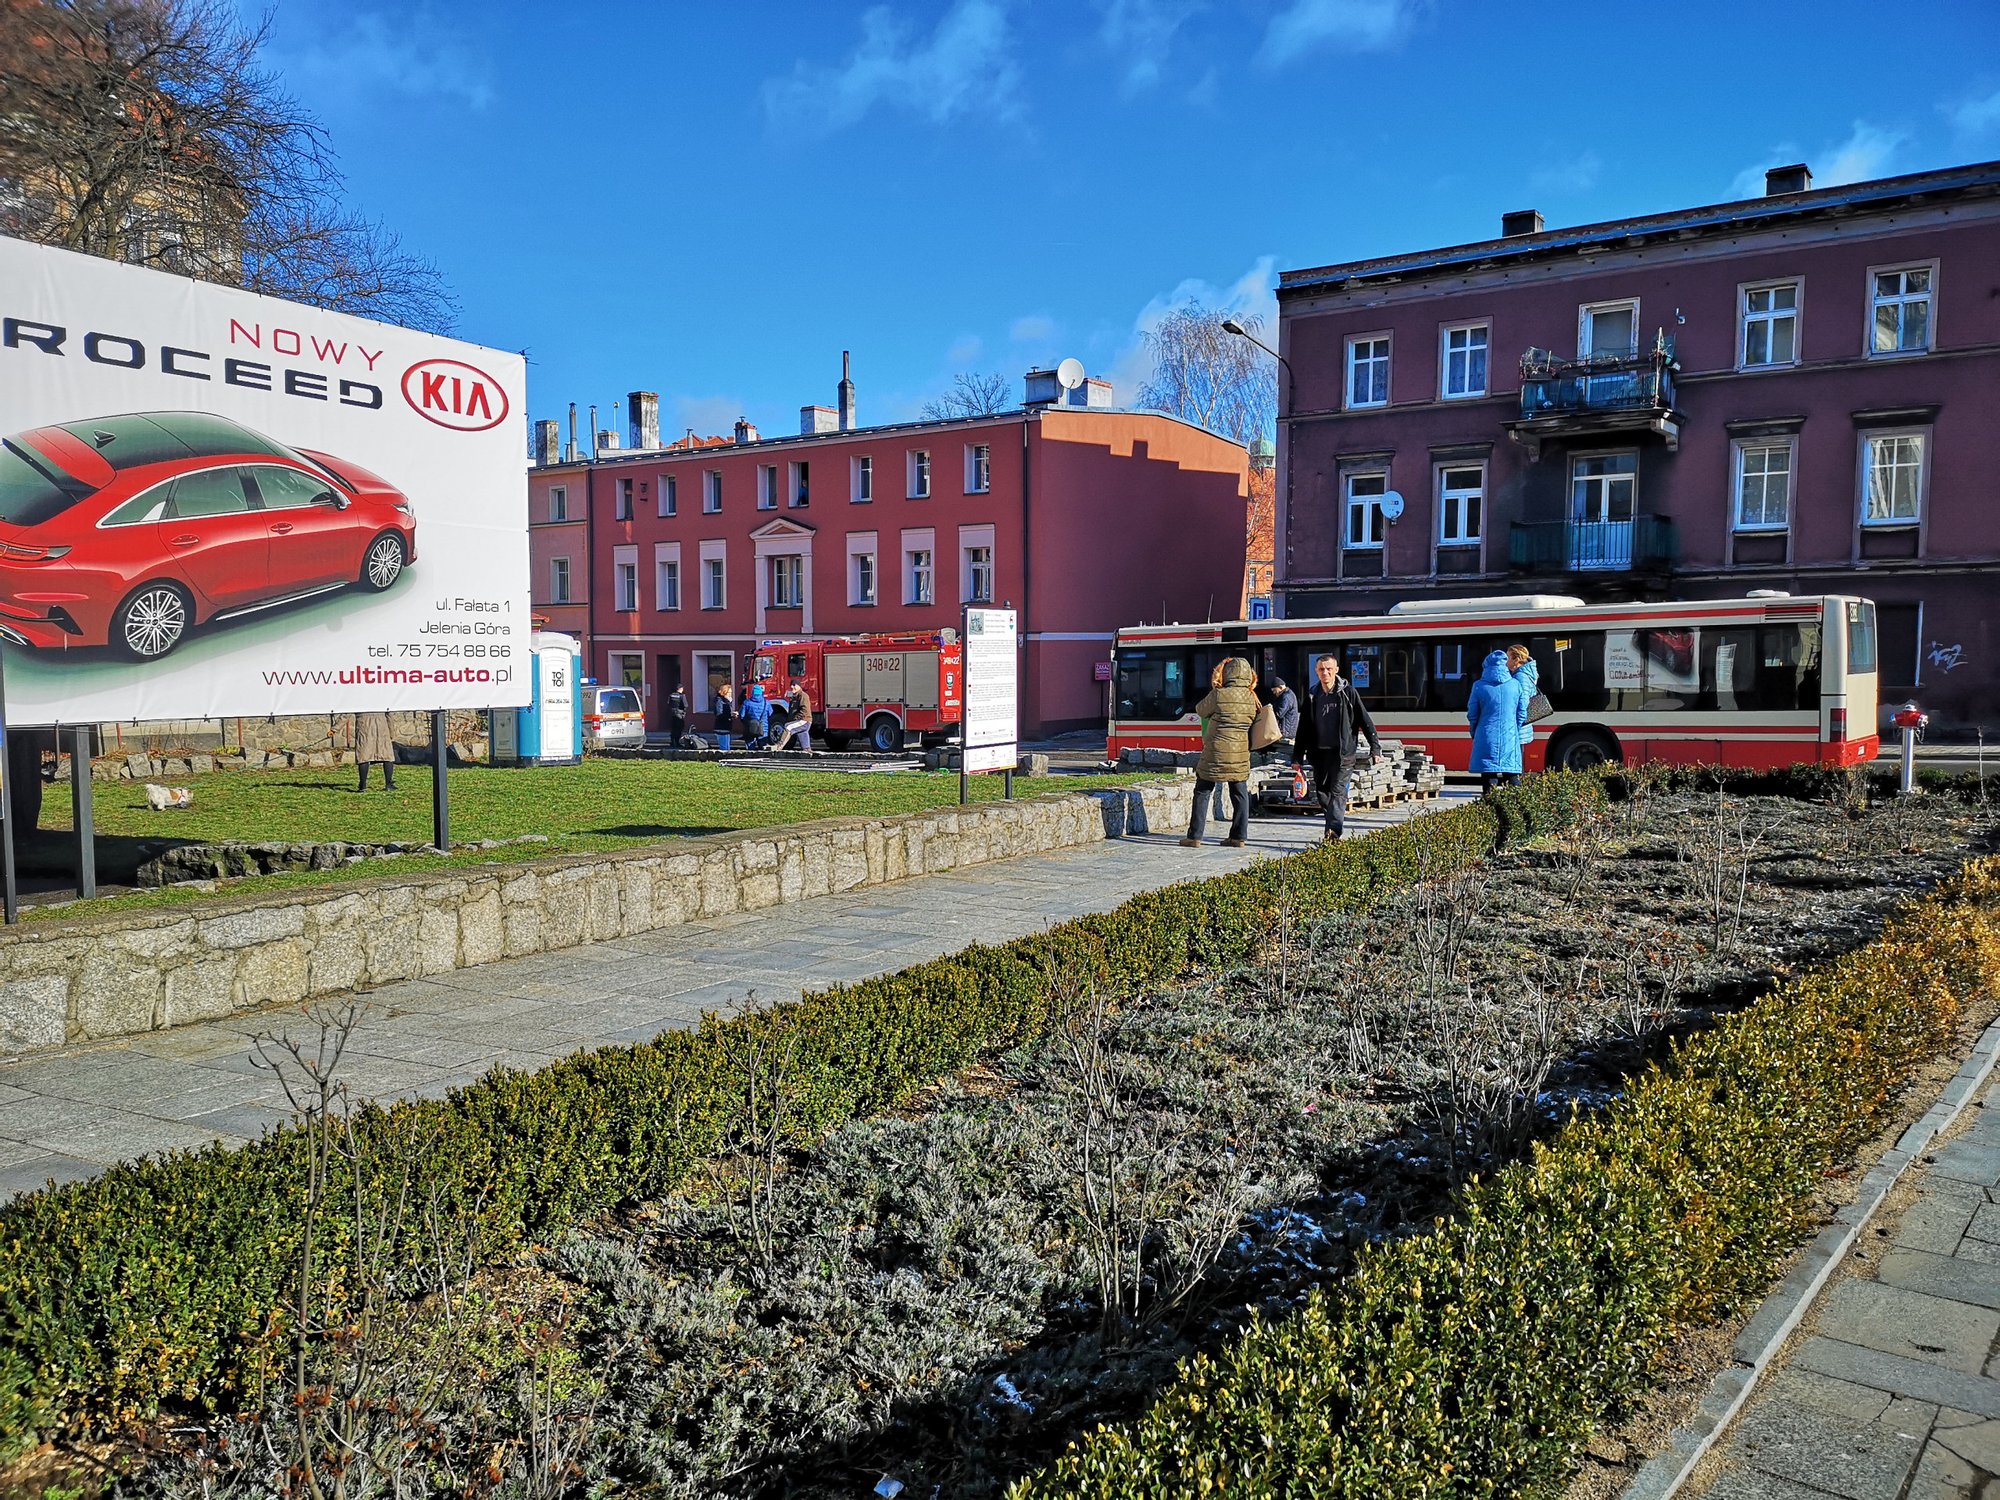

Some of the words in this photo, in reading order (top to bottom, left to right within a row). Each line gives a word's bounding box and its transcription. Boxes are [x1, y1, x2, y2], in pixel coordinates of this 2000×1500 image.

[230, 318, 384, 372] NOWY
[3, 317, 383, 410] ROCEED
[421, 370, 492, 420] KIA
[436, 598, 451, 611] ul.
[455, 598, 500, 613] Fałata
[504, 600, 511, 613] 1
[419, 621, 471, 635] Jelenia
[474, 622, 511, 636] Góra
[367, 644, 393, 658] tel.
[397, 644, 421, 658] 75
[425, 644, 460, 658] 754
[463, 644, 486, 658] 88
[489, 644, 511, 658] 66
[866, 657, 883, 672] 348
[888, 657, 900, 671] 22
[262, 665, 512, 686] www.ultima-auto.pl
